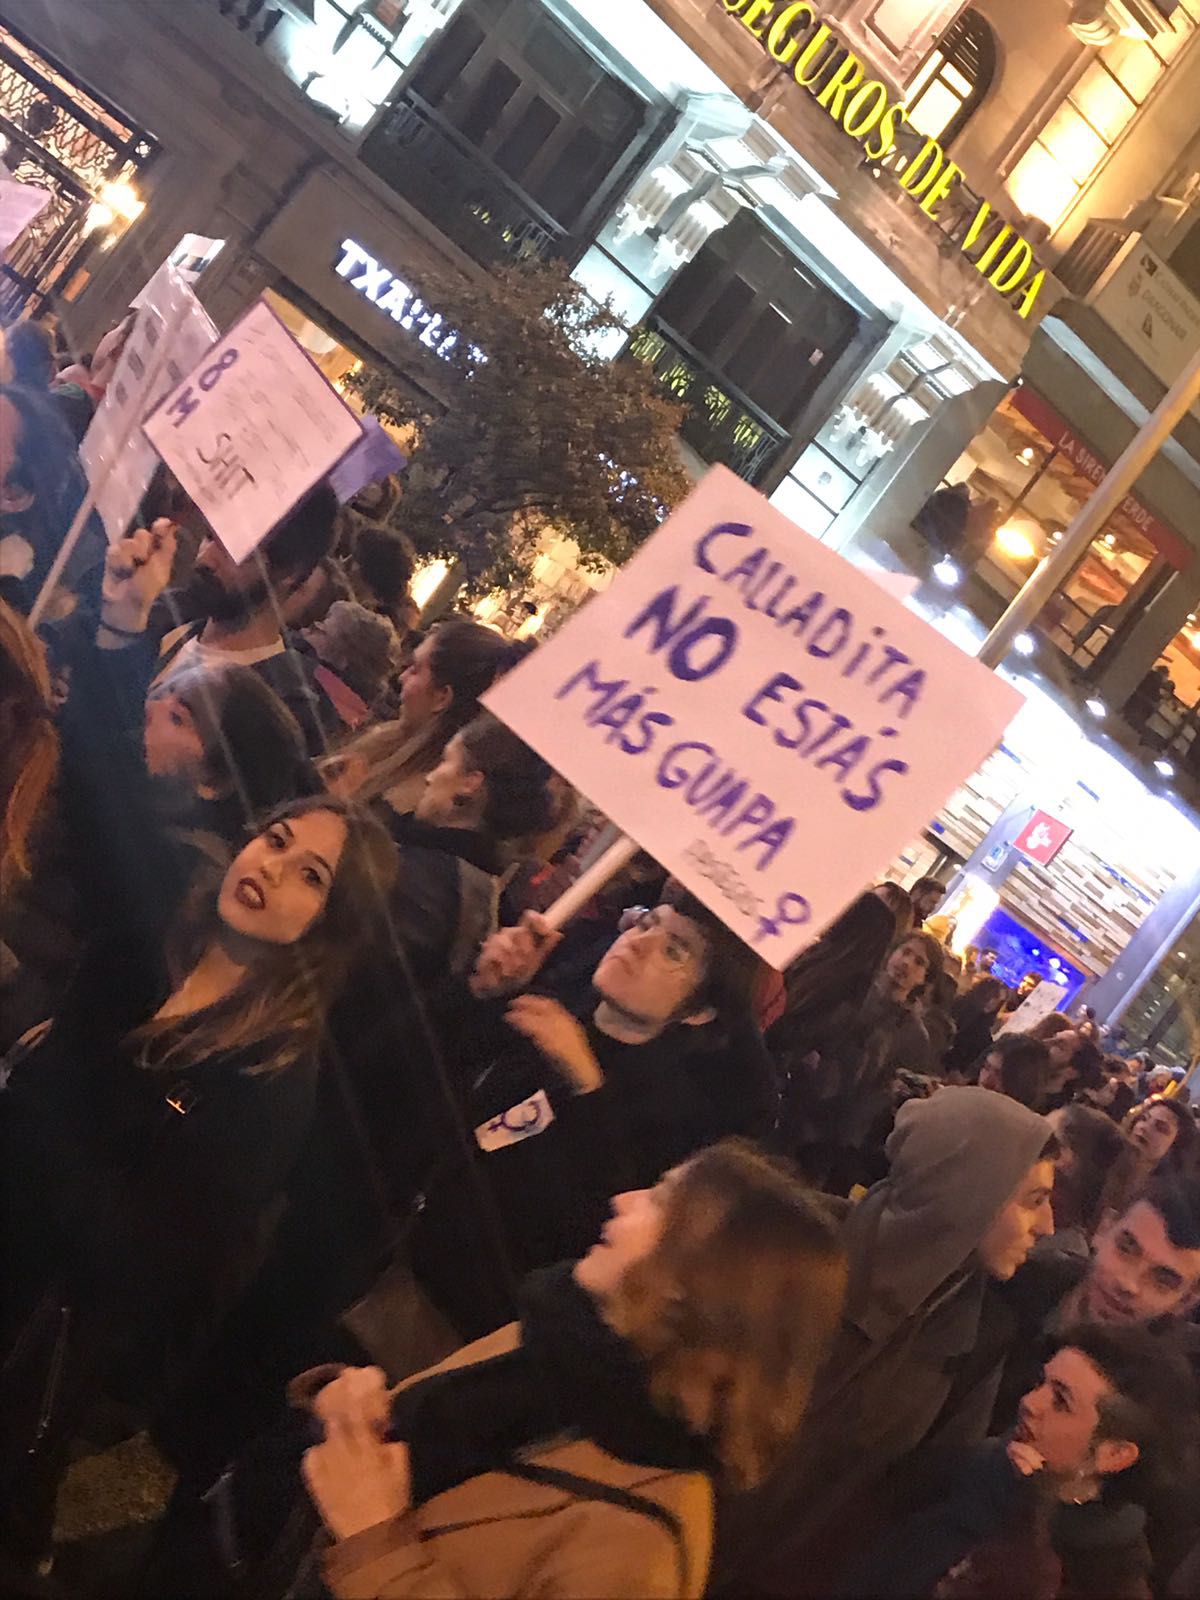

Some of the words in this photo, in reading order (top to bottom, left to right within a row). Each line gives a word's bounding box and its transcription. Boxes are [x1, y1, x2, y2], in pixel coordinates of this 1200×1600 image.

[899, 135, 966, 220] DE
[961, 200, 1047, 319] VIDA
[1058, 430, 1076, 456] LA
[1121, 495, 1156, 532] ERDE
[554, 660, 675, 755] MÁS
[655, 740, 797, 872] GUAPA
[622, 584, 739, 682] NO
[742, 671, 910, 812] ESTÁS
